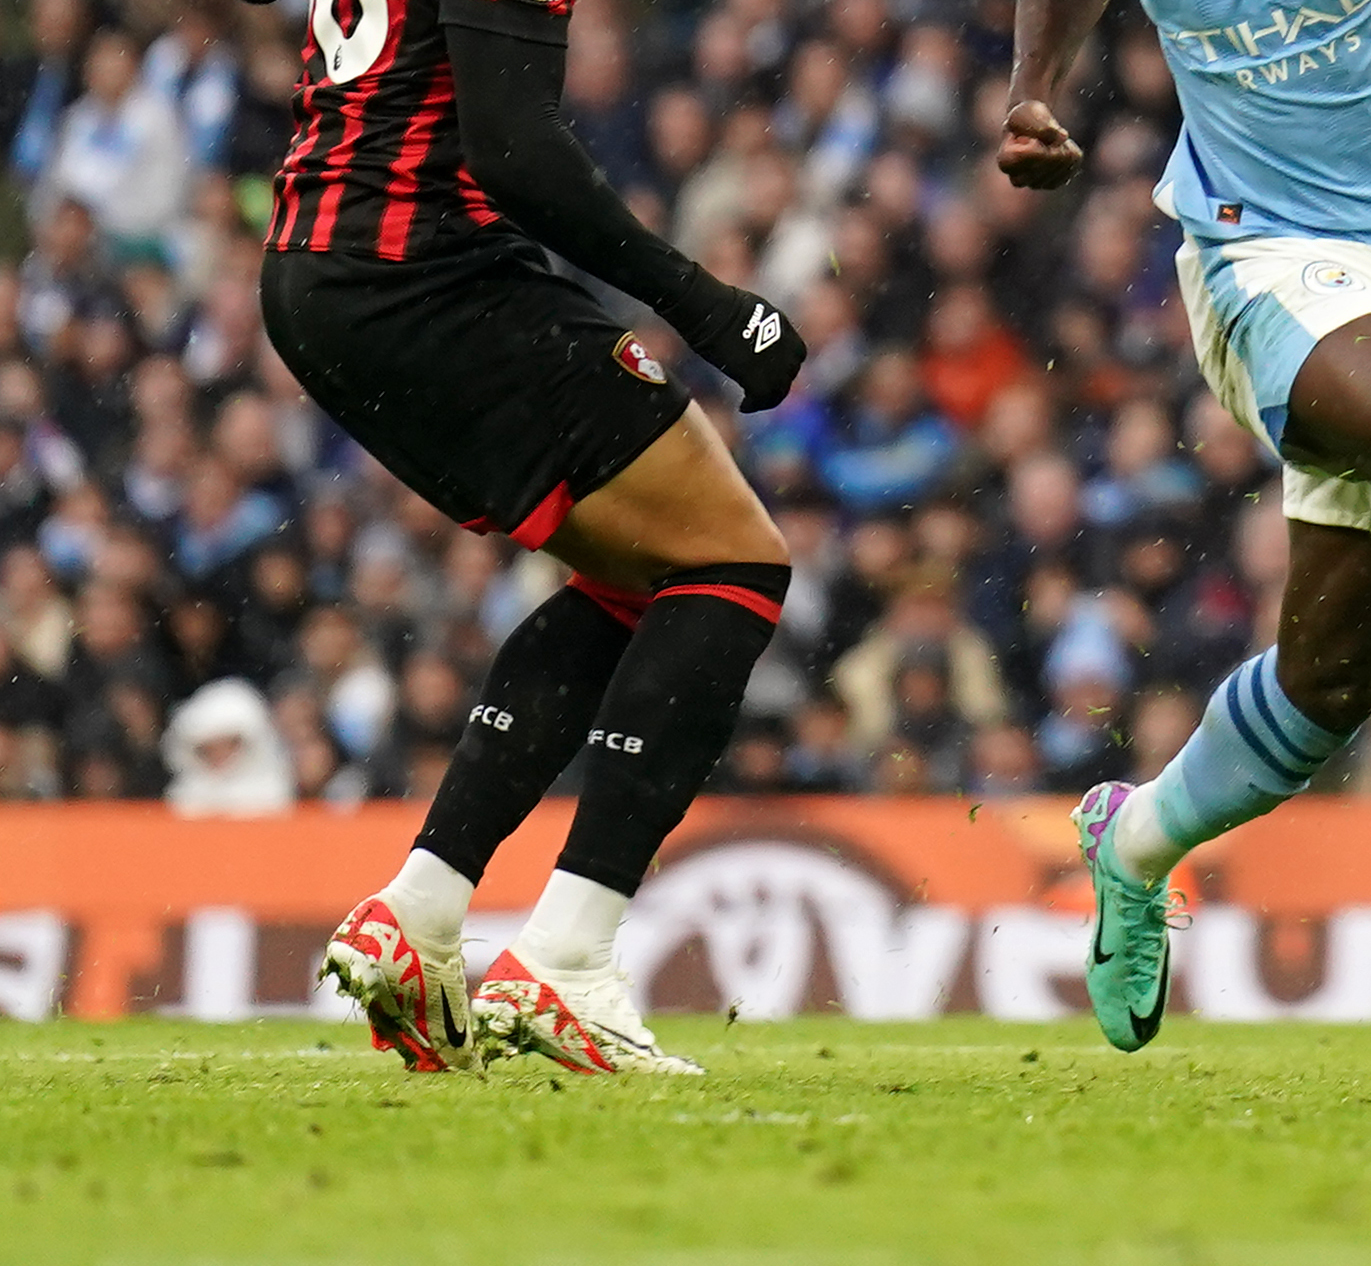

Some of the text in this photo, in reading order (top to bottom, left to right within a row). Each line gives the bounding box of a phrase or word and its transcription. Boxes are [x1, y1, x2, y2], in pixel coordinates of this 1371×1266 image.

[1236, 30, 1361, 90] RWAYS
[469, 704, 514, 732] FCB
[587, 728, 644, 755] FCB
